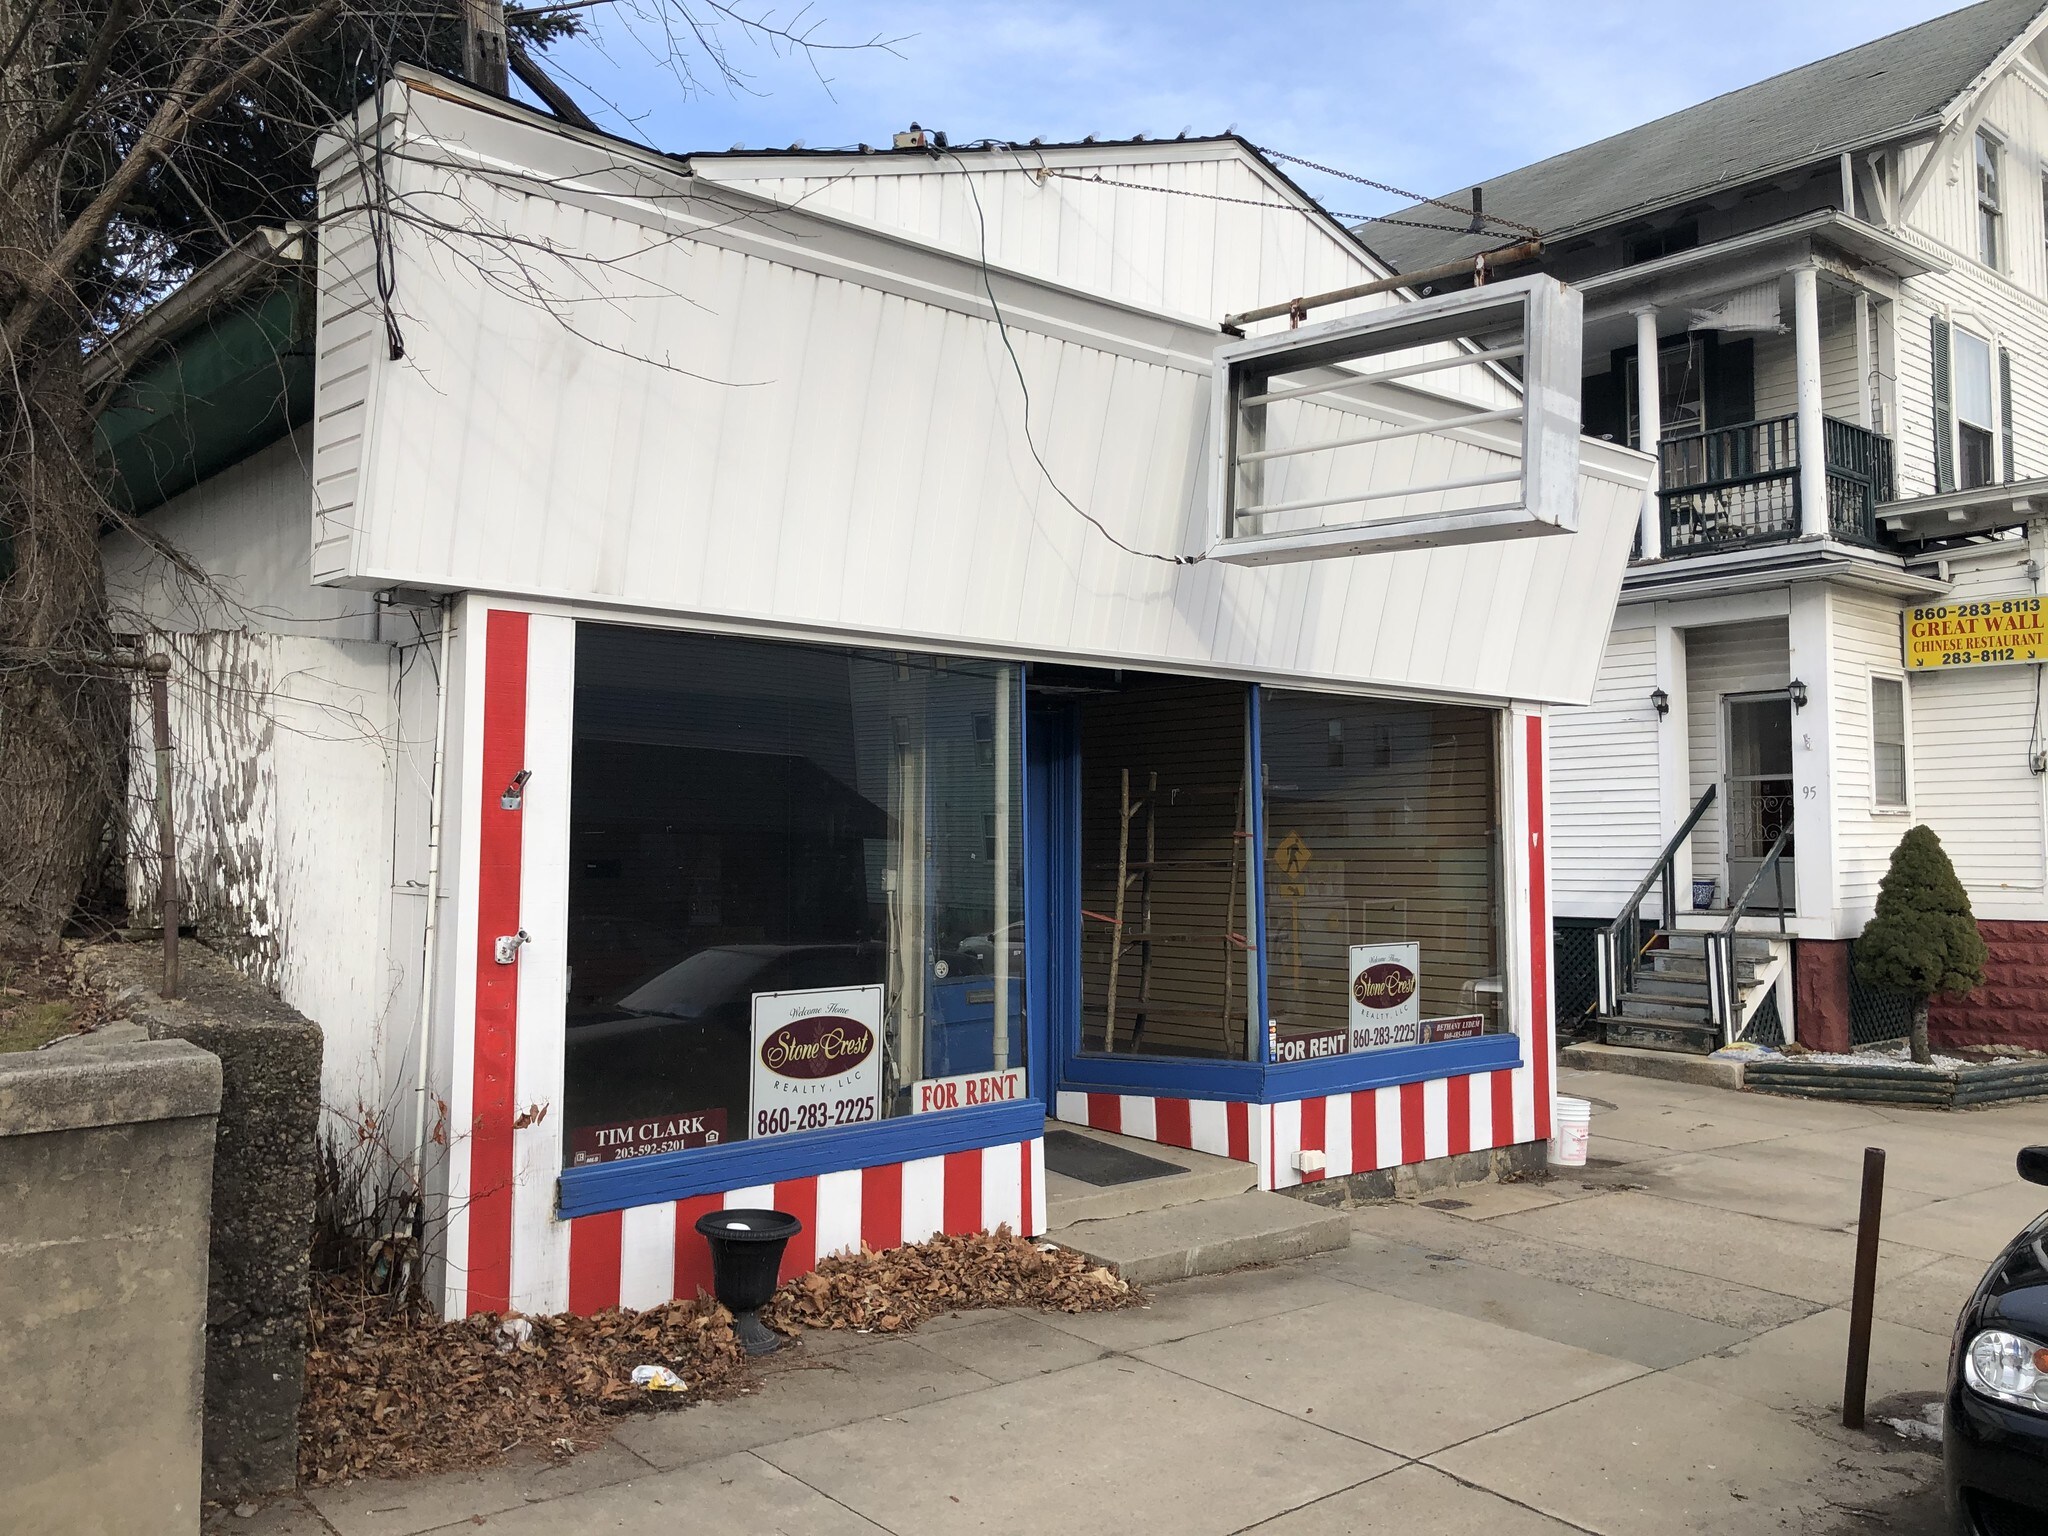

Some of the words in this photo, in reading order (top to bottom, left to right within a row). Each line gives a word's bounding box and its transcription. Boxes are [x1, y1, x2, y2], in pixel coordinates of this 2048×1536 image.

[1914, 599, 2041, 621] 860-283-8113
[1911, 618, 1979, 638] GREAT
[1984, 613, 2045, 632] WALL
[1913, 638, 1964, 653] CHINESE
[1966, 632, 2044, 649] RESTAURANT
[1942, 648, 2015, 665] 283-8112
[1802, 785, 1817, 800] 95
[789, 1006, 822, 1019] Welcome
[824, 1002, 850, 1015] Home
[1394, 1004, 1409, 1016] LLC
[1353, 1023, 1416, 1049] 860-283-2225
[767, 1031, 819, 1069] Stone
[820, 1027, 869, 1060] Crest
[1276, 1041, 1306, 1063] FOR
[1309, 1034, 1347, 1060] RENT
[773, 1080, 832, 1094] REALTY,
[838, 1071, 862, 1088] LLC
[921, 1082, 959, 1112] FOR
[965, 1073, 1019, 1106] RENT
[757, 1096, 875, 1136] 860-283-2225
[595, 1126, 634, 1147] TIM
[638, 1116, 705, 1141] CLARK
[614, 1138, 686, 1161] 203-592-5201
